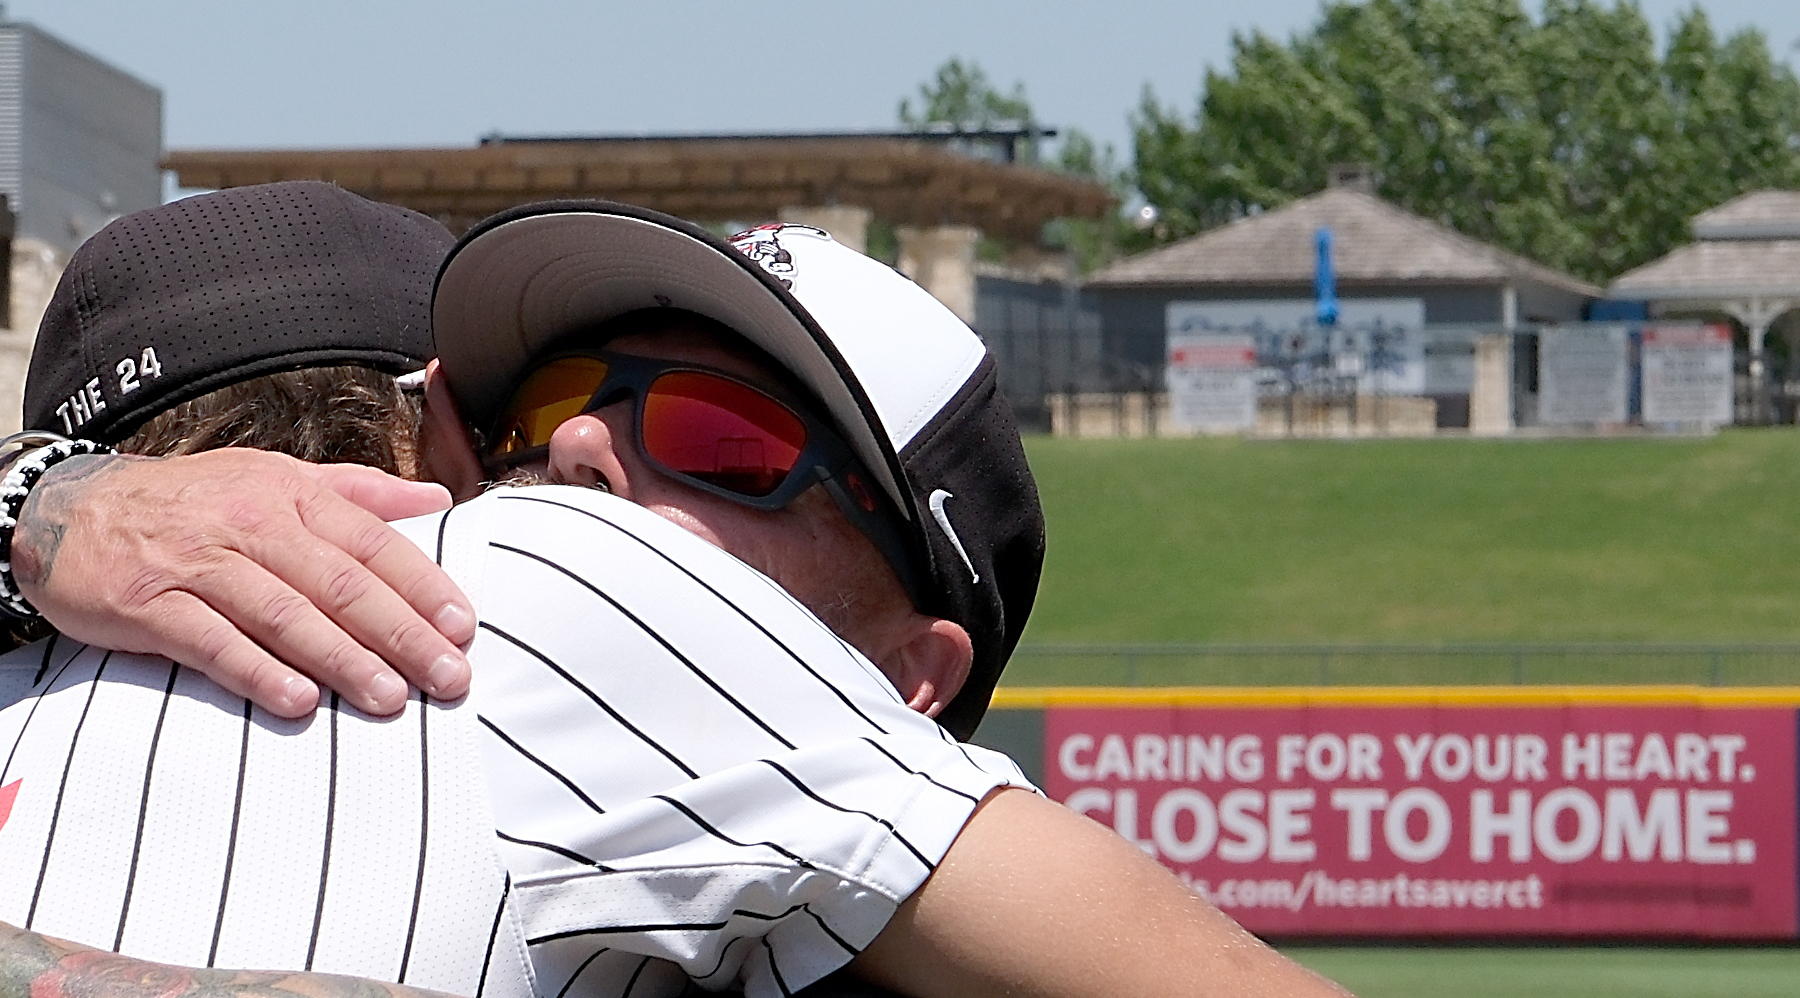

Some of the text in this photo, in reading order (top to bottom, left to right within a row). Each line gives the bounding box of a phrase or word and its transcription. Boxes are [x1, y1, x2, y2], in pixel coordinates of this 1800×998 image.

[56, 346, 162, 435] THE 24
[1059, 731, 1756, 783] CARING FOR YOUR HEART.
[1330, 786, 1452, 864] TO
[1469, 786, 1756, 864] HOME.
[1179, 870, 1543, 912] s.com/heartsaverct
